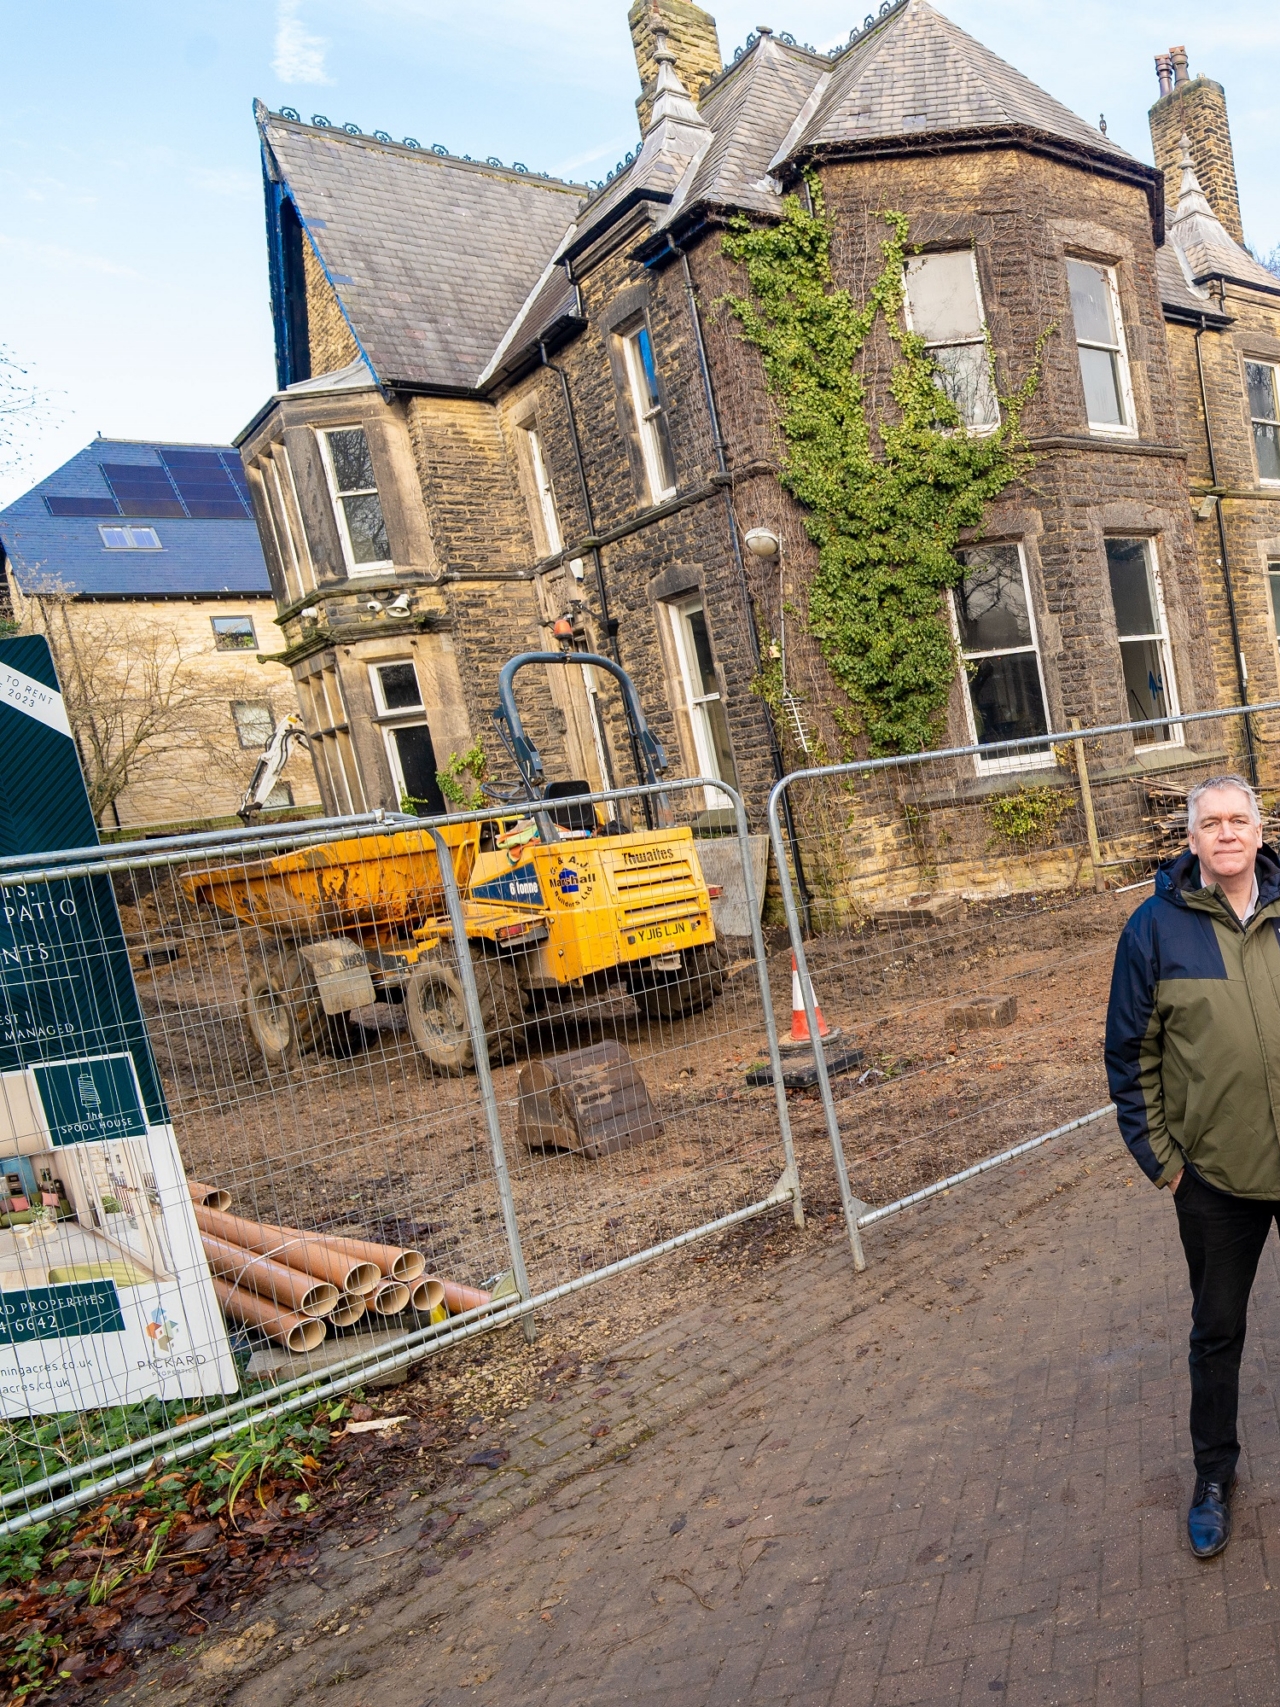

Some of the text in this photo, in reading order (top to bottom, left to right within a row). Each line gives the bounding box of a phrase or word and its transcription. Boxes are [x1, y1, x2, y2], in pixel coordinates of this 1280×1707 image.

[6, 675, 53, 705] TO RENT
[8, 688, 35, 707] 2023
[622, 848, 674, 865] Thwaites
[509, 881, 538, 895] 6 tonne
[549, 873, 596, 888] Marshall
[3, 898, 76, 924] PATIO
[638, 928, 662, 941] YJ16
[2, 943, 49, 964] NTS
[5, 1023, 75, 1041] MANAGED
[86, 1112, 103, 1121] The
[61, 1117, 133, 1134] SPOOL HOUSE
[20, 1293, 105, 1313] PROPERTIES
[15, 1315, 58, 1332] 6642
[137, 1354, 206, 1371] PICKARD
